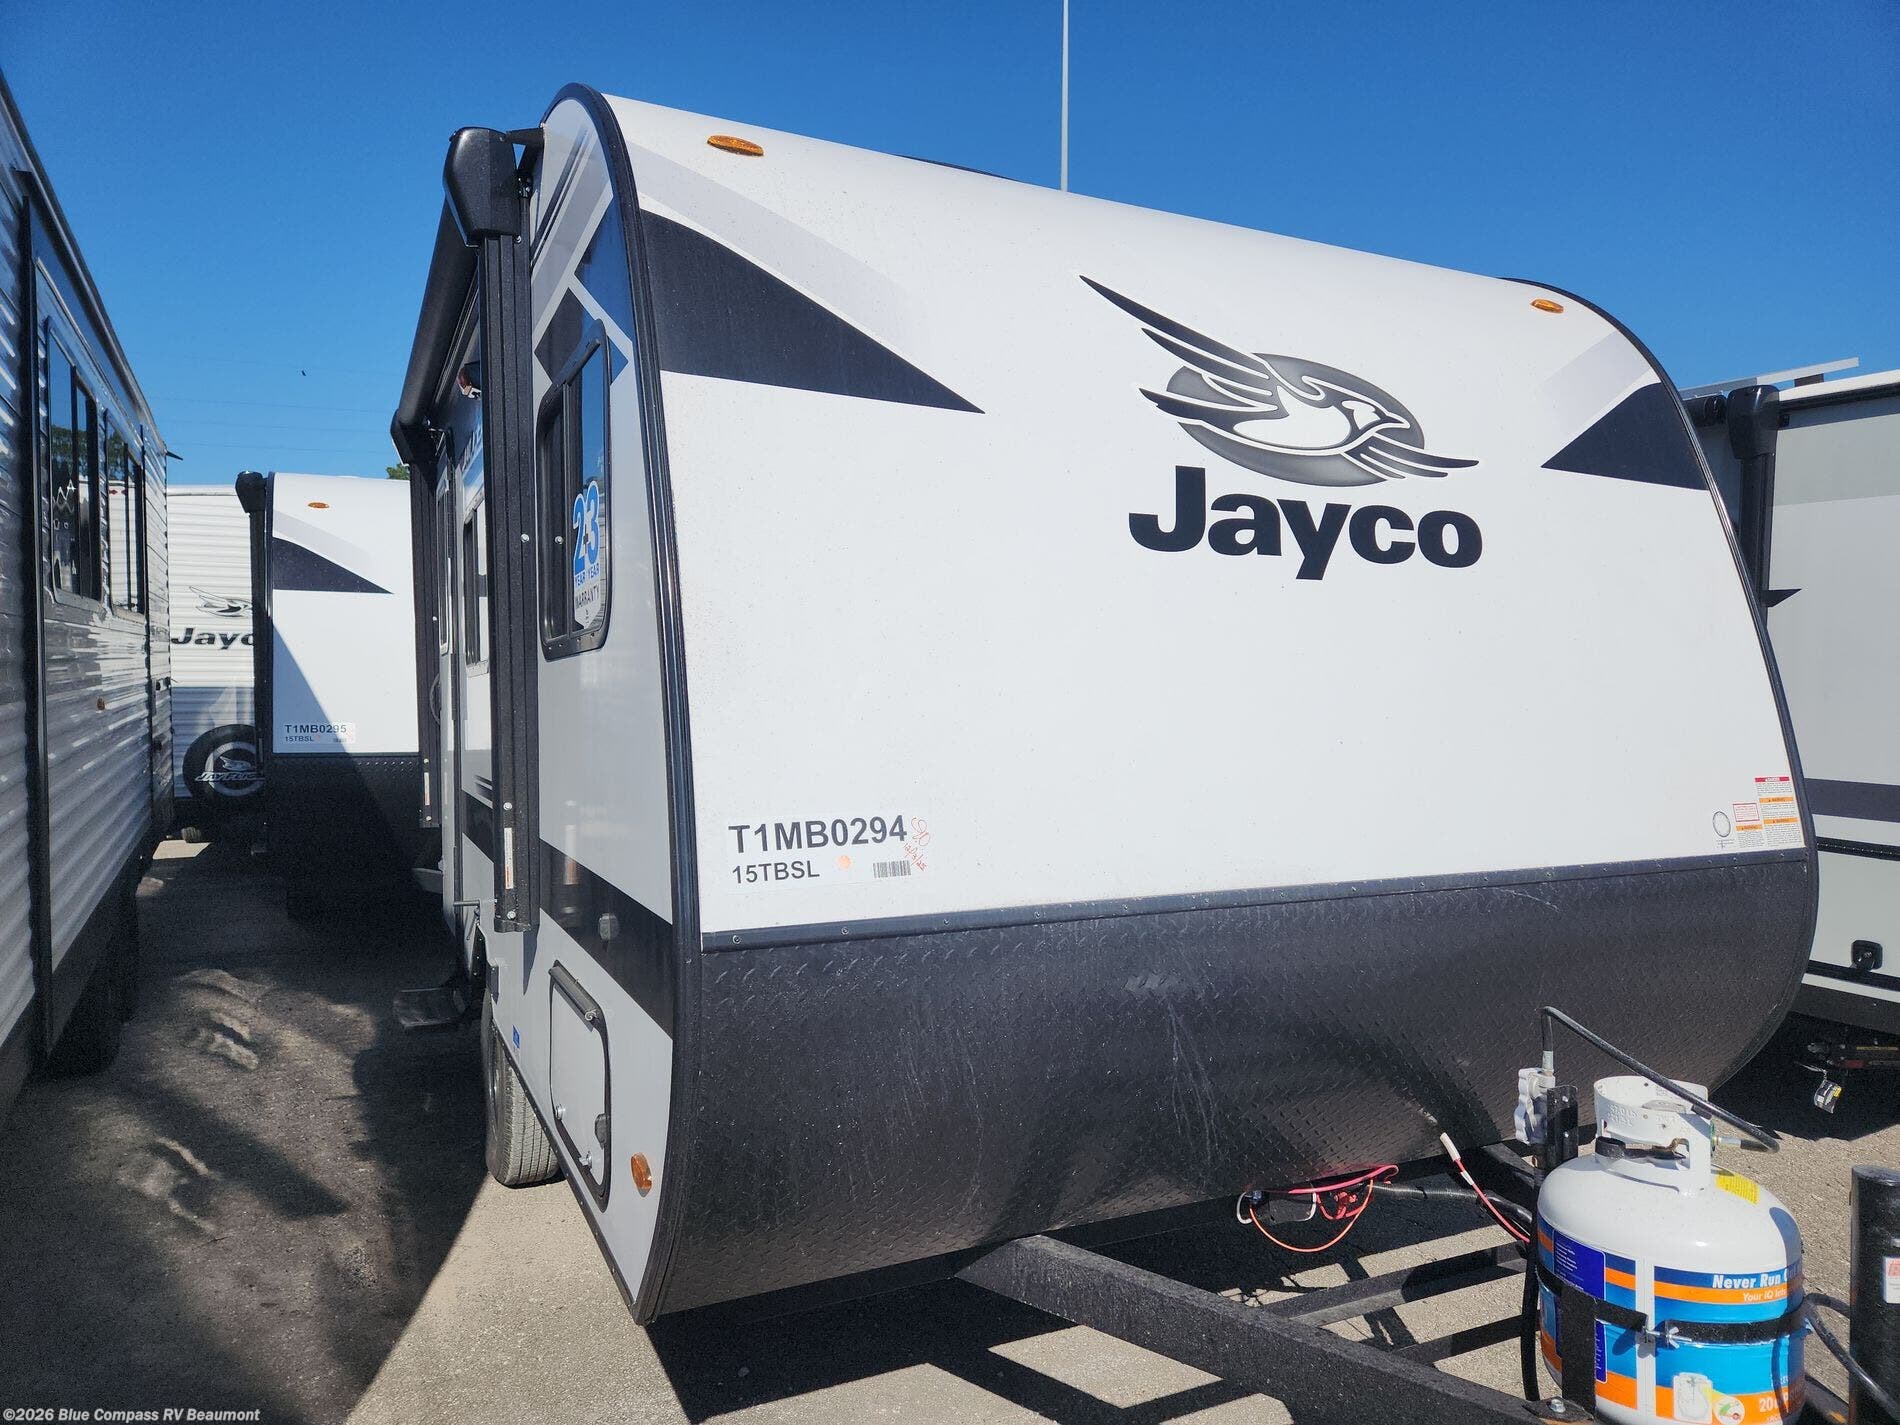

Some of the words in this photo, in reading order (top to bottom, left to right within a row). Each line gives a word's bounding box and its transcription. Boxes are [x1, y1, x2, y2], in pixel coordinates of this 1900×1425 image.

[1128, 465, 1483, 580] Jayco
[575, 571, 586, 587] YEAR
[588, 563, 600, 578] YEAR
[575, 584, 600, 609] WARRANTY
[170, 628, 253, 650] Jayc
[284, 724, 347, 734] T1MB0295
[728, 815, 908, 854] T1MB0294
[732, 860, 820, 884] 15TBSL
[1712, 1274, 1757, 1289] Never
[1759, 1273, 1781, 1288] Run
[1743, 1292, 1763, 1302] Your
